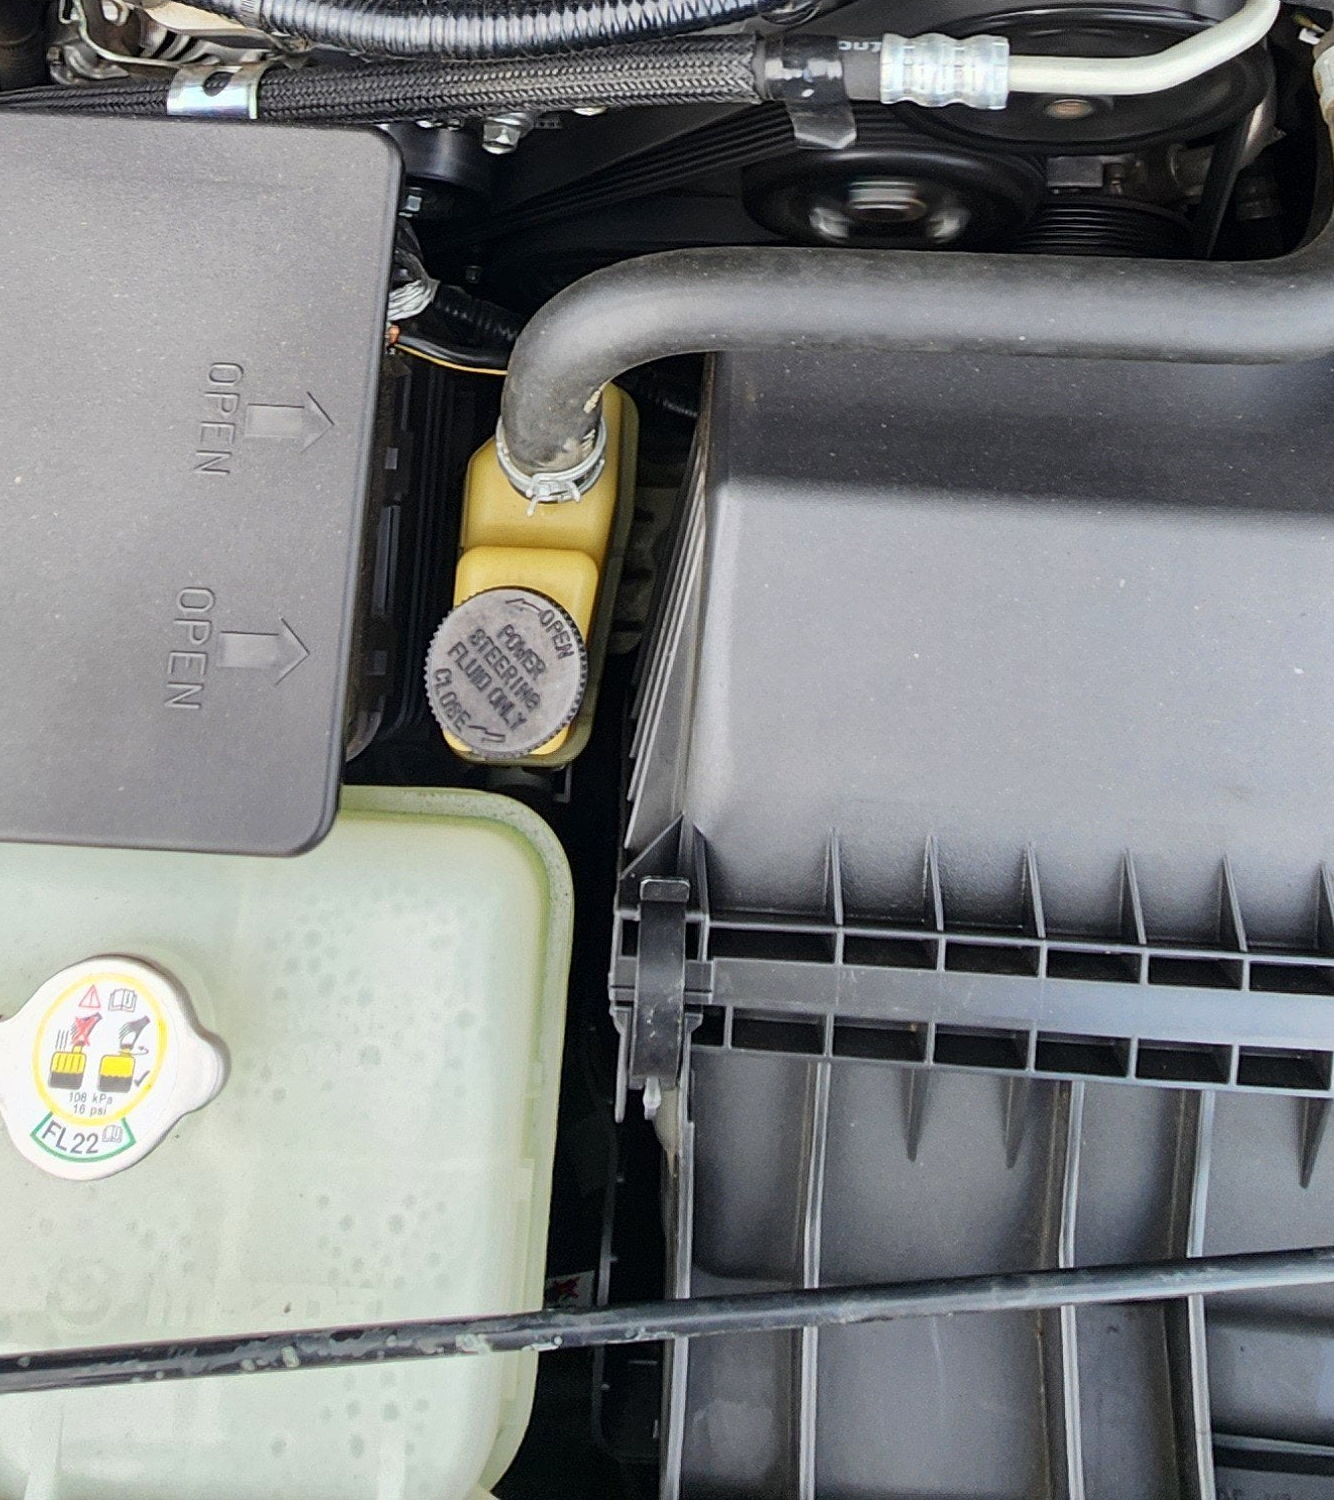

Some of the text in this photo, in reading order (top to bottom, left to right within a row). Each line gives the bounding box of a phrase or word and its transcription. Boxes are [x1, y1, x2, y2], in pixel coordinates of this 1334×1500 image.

[193, 361, 244, 476] OPEN
[165, 586, 216, 710] OPEN
[497, 624, 546, 680] POWER
[538, 609, 575, 659] OPEN
[434, 667, 471, 732] CLOSE
[447, 641, 527, 731] FLUID ONLY
[469, 628, 541, 713] STEERING
[69, 1092, 113, 1105] 108 kPa
[90, 1105, 107, 1117] psi
[41, 1119, 99, 1154] FL22
